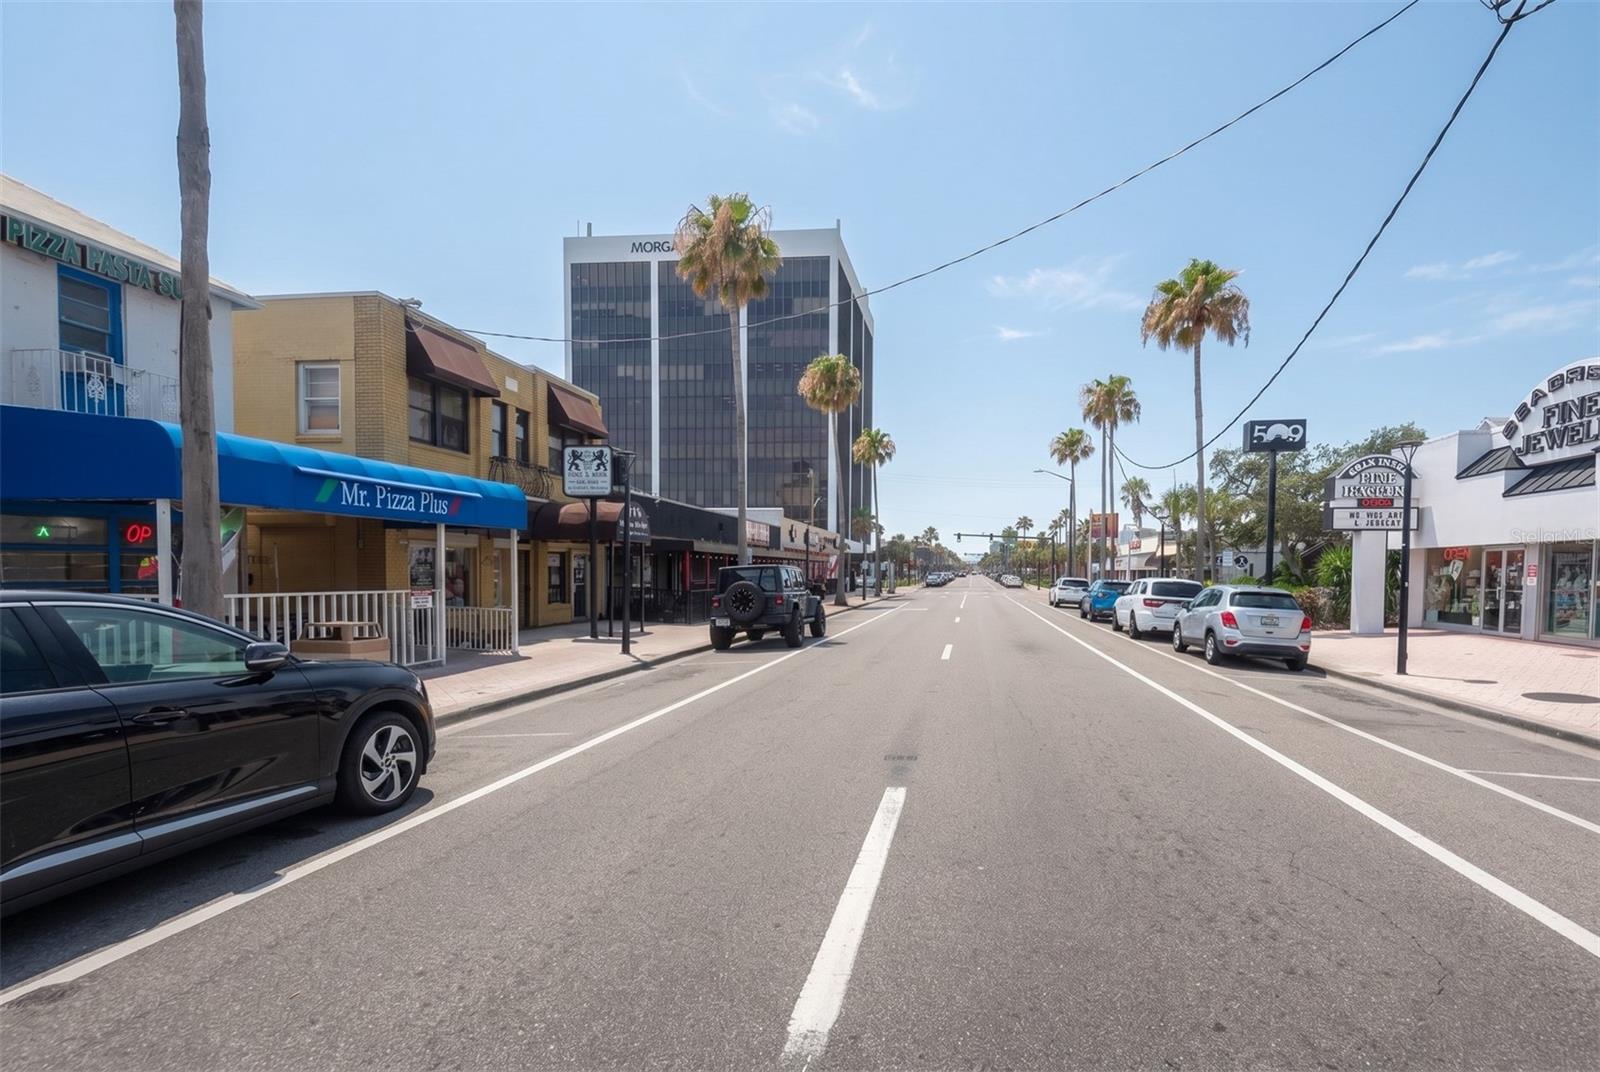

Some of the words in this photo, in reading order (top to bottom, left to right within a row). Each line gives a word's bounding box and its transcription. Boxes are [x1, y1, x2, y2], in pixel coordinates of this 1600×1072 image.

[7, 217, 81, 266] PIZZA
[86, 245, 151, 290] PASTA
[1541, 391, 1600, 429] FINE
[1514, 417, 1600, 457] JEWEL
[340, 480, 371, 508] Mr.
[375, 485, 416, 512] Pizza
[419, 491, 448, 515] Plus
